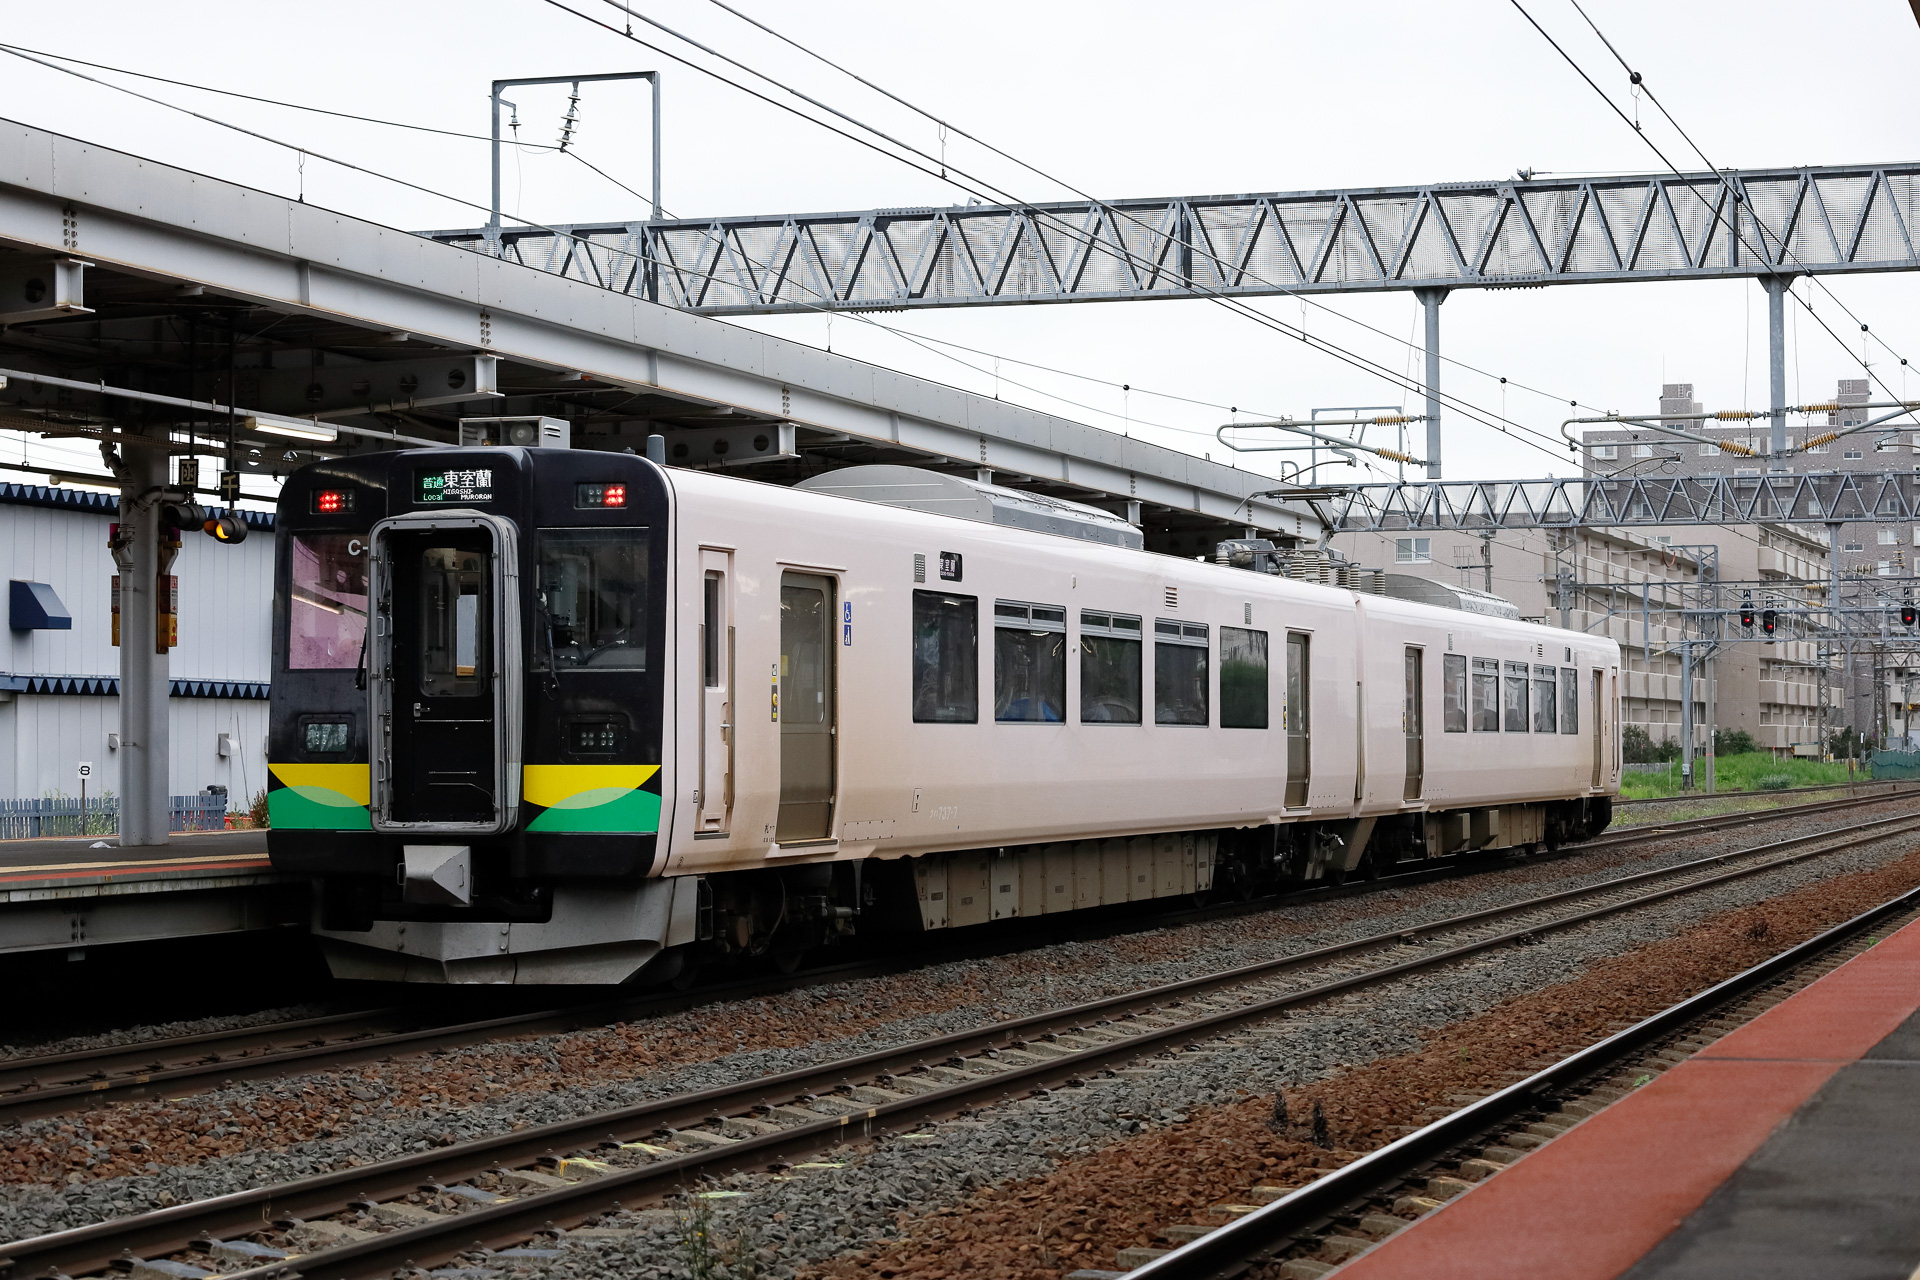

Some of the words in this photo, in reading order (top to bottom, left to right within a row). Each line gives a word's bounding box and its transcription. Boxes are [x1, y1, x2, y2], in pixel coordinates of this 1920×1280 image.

[221, 474, 239, 500] 千
[423, 477, 444, 489] 普通
[443, 469, 492, 489] 東室蘭
[423, 493, 443, 501] Local
